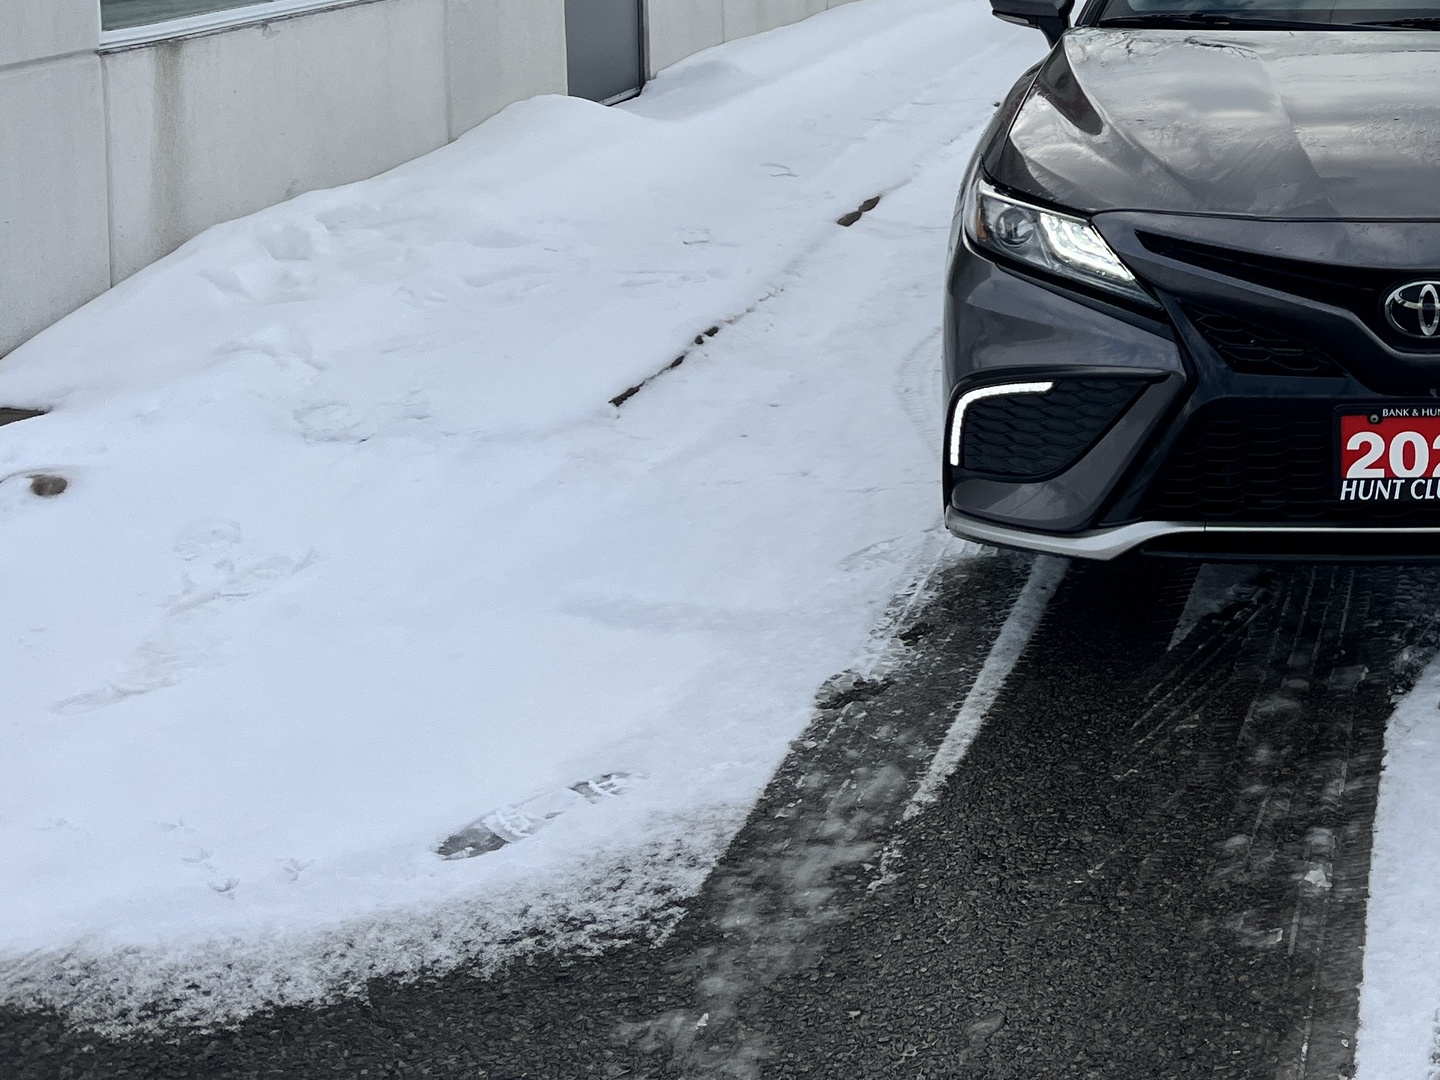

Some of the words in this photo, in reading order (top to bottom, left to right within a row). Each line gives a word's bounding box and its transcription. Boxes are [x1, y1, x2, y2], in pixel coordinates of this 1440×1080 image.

[1382, 408, 1409, 417] BANK
[1412, 408, 1419, 417] &
[1339, 478, 1406, 501] HUNT
